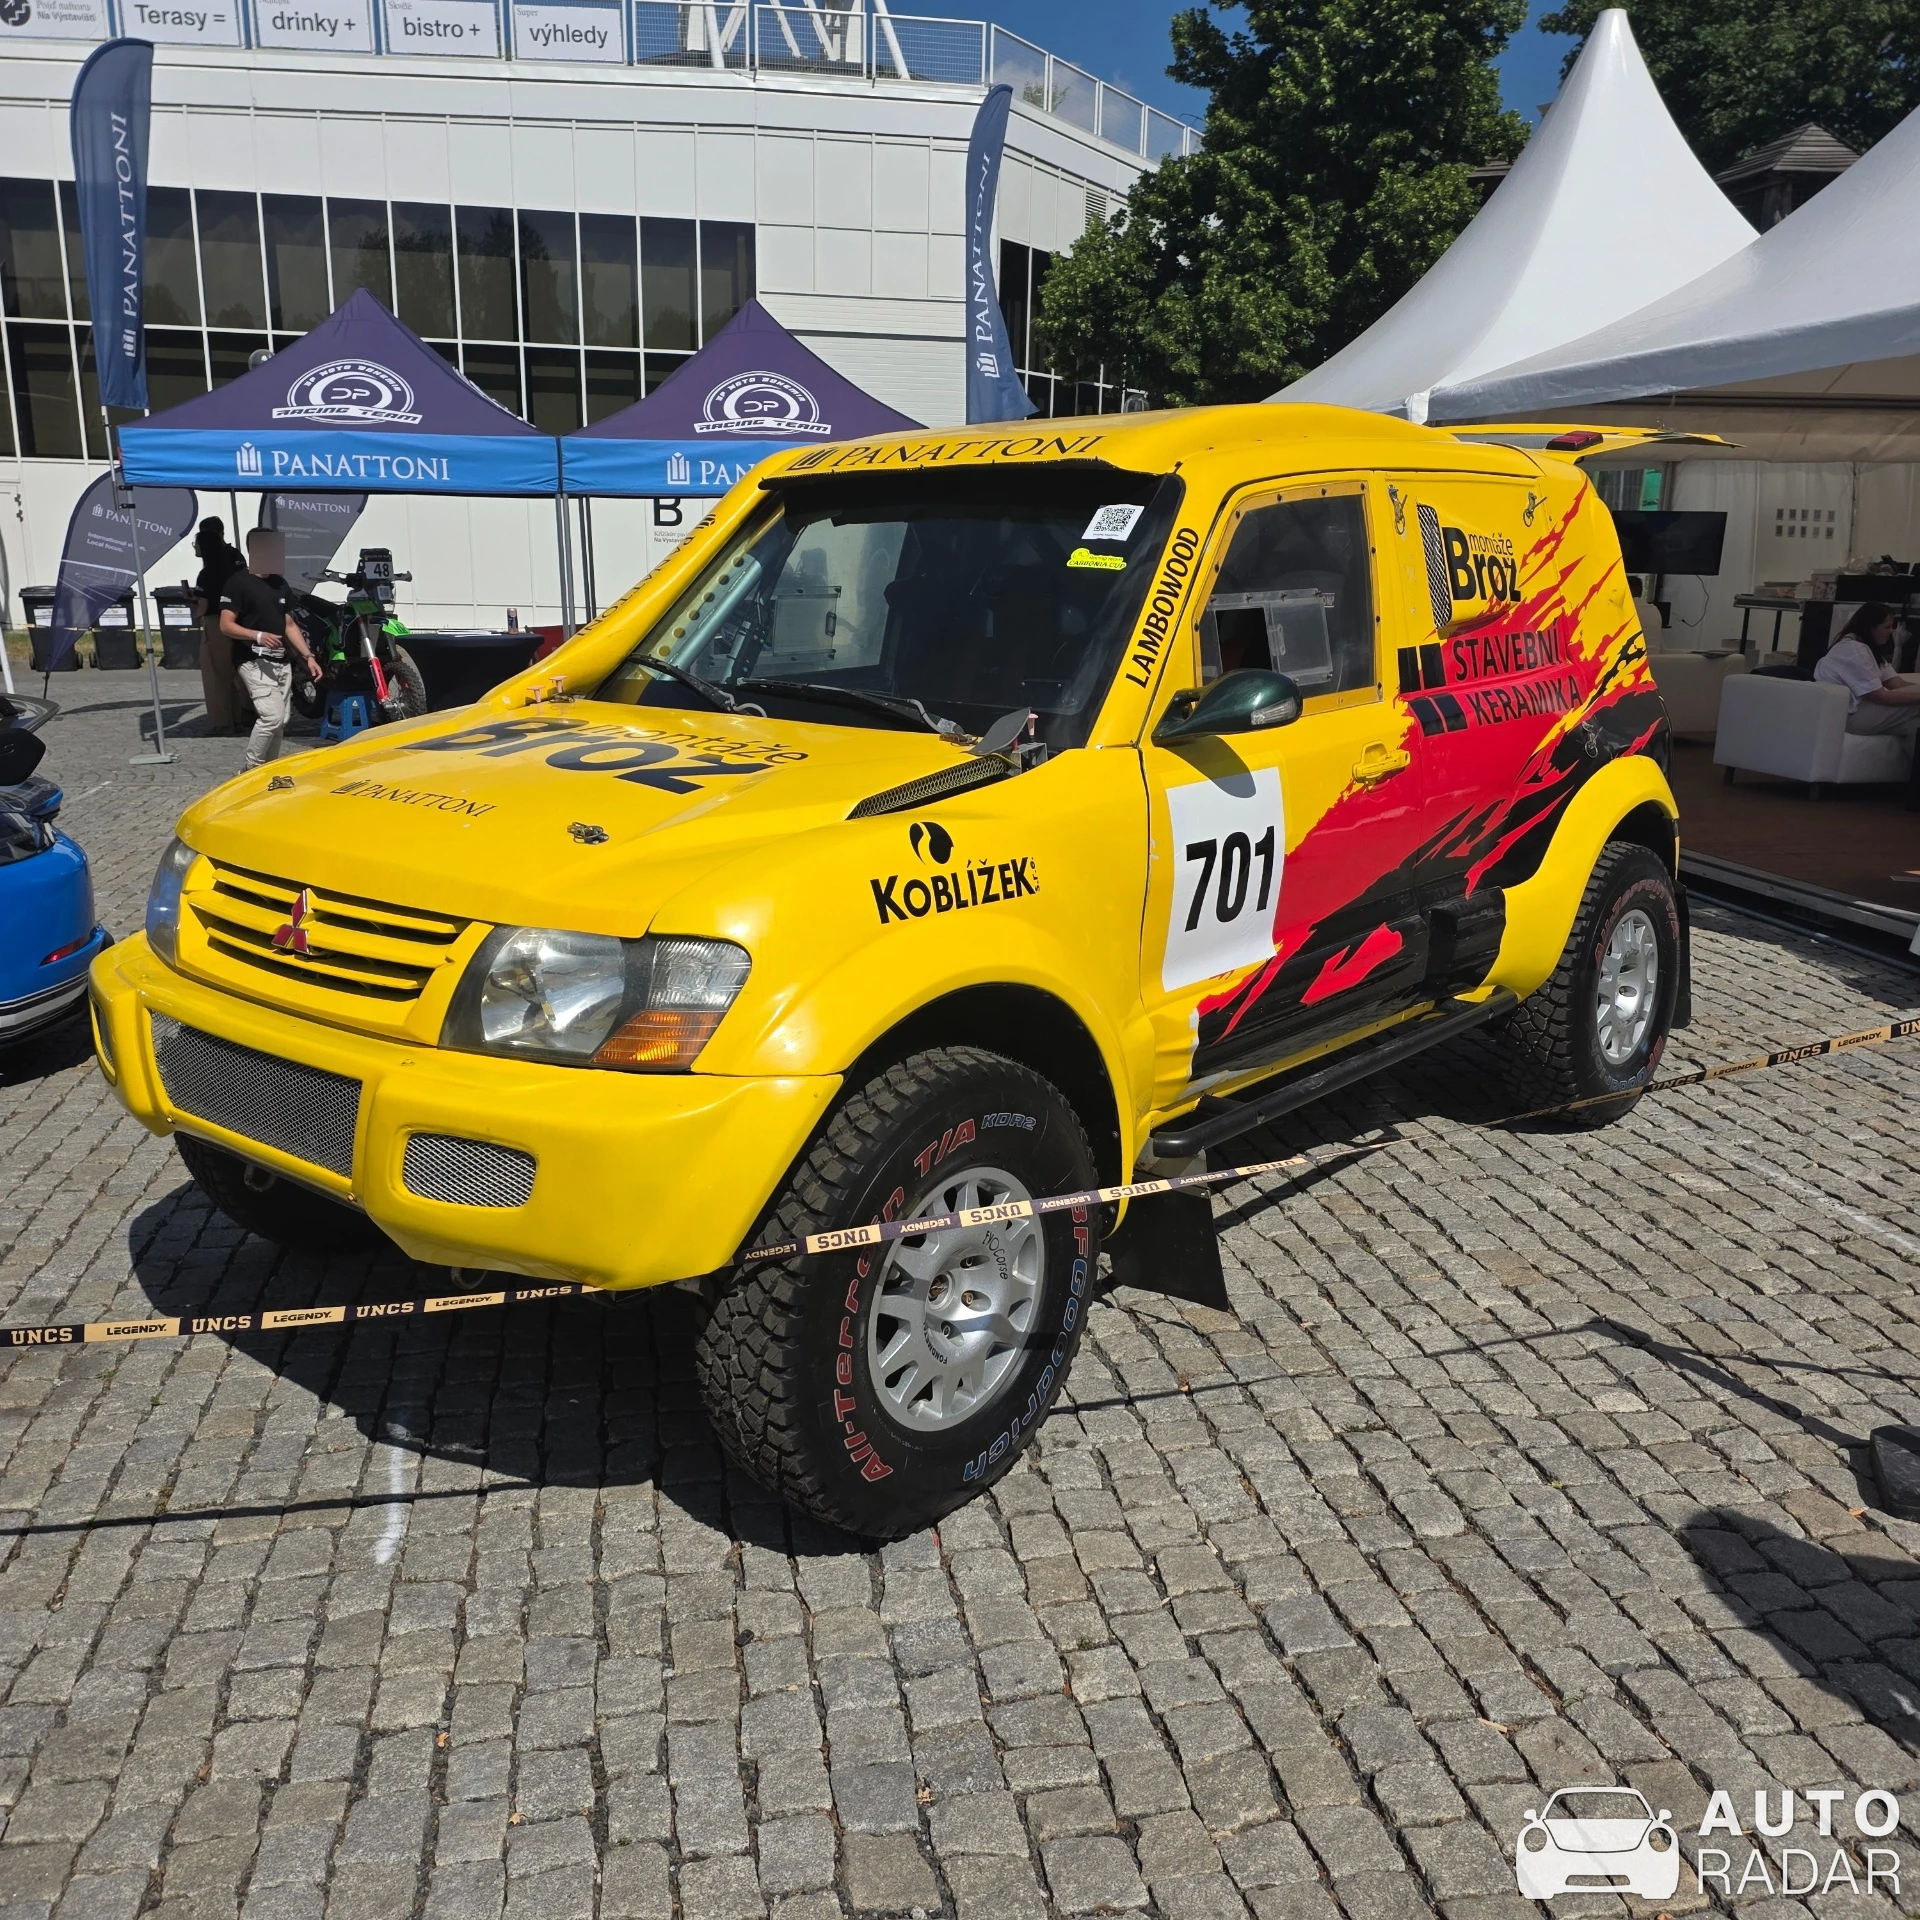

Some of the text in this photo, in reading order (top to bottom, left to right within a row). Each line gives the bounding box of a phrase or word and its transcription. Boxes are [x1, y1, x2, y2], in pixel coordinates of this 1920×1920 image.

[134, 5, 226, 31] Terasy =
[272, 12, 356, 38] drinky +
[516, 8, 538, 17] Super
[403, 17, 480, 38] bistro +
[529, 24, 608, 48] výhledy
[110, 112, 138, 318] PANATTONI
[971, 152, 993, 344] PANATTONI
[319, 365, 352, 377] MOTO
[727, 377, 756, 391] MOTO
[276, 407, 419, 421] RACING TEAM
[698, 419, 828, 432] RACING TEAM
[829, 435, 1106, 468] PANATTONI
[271, 450, 450, 481] PANATTONI
[288, 500, 350, 513] PANATTONI
[653, 498, 683, 526] B
[105, 509, 172, 536] PANTTONI
[1468, 532, 1514, 556] montáže
[374, 563, 390, 577] 48
[1442, 527, 1521, 602] Brož
[1125, 528, 1199, 689] LAMBOWOOD
[1452, 625, 1563, 681] STAVEBNÍ
[1466, 675, 1584, 727] KERAMIKA
[578, 723, 809, 765] montáže
[350, 782, 498, 817] PANATTONI
[870, 857, 1036, 924] KOBLÍŽEK
[1185, 825, 1275, 932] 701
[1651, 1074, 1697, 1091] UNCS
[1777, 1044, 1822, 1063] UNCS
[1837, 1031, 1882, 1047] LEGENDY.
[913, 1118, 976, 1177] T/A
[981, 1112, 1037, 1131] KDR2
[1110, 1182, 1160, 1199] UNCS
[971, 1204, 1022, 1223] UNCS
[817, 1232, 871, 1249] UNCS
[11, 1285, 572, 1345] UNCS LEGENDY. UNCS LEGENDY. UNCS LEGENDY. UNCS
